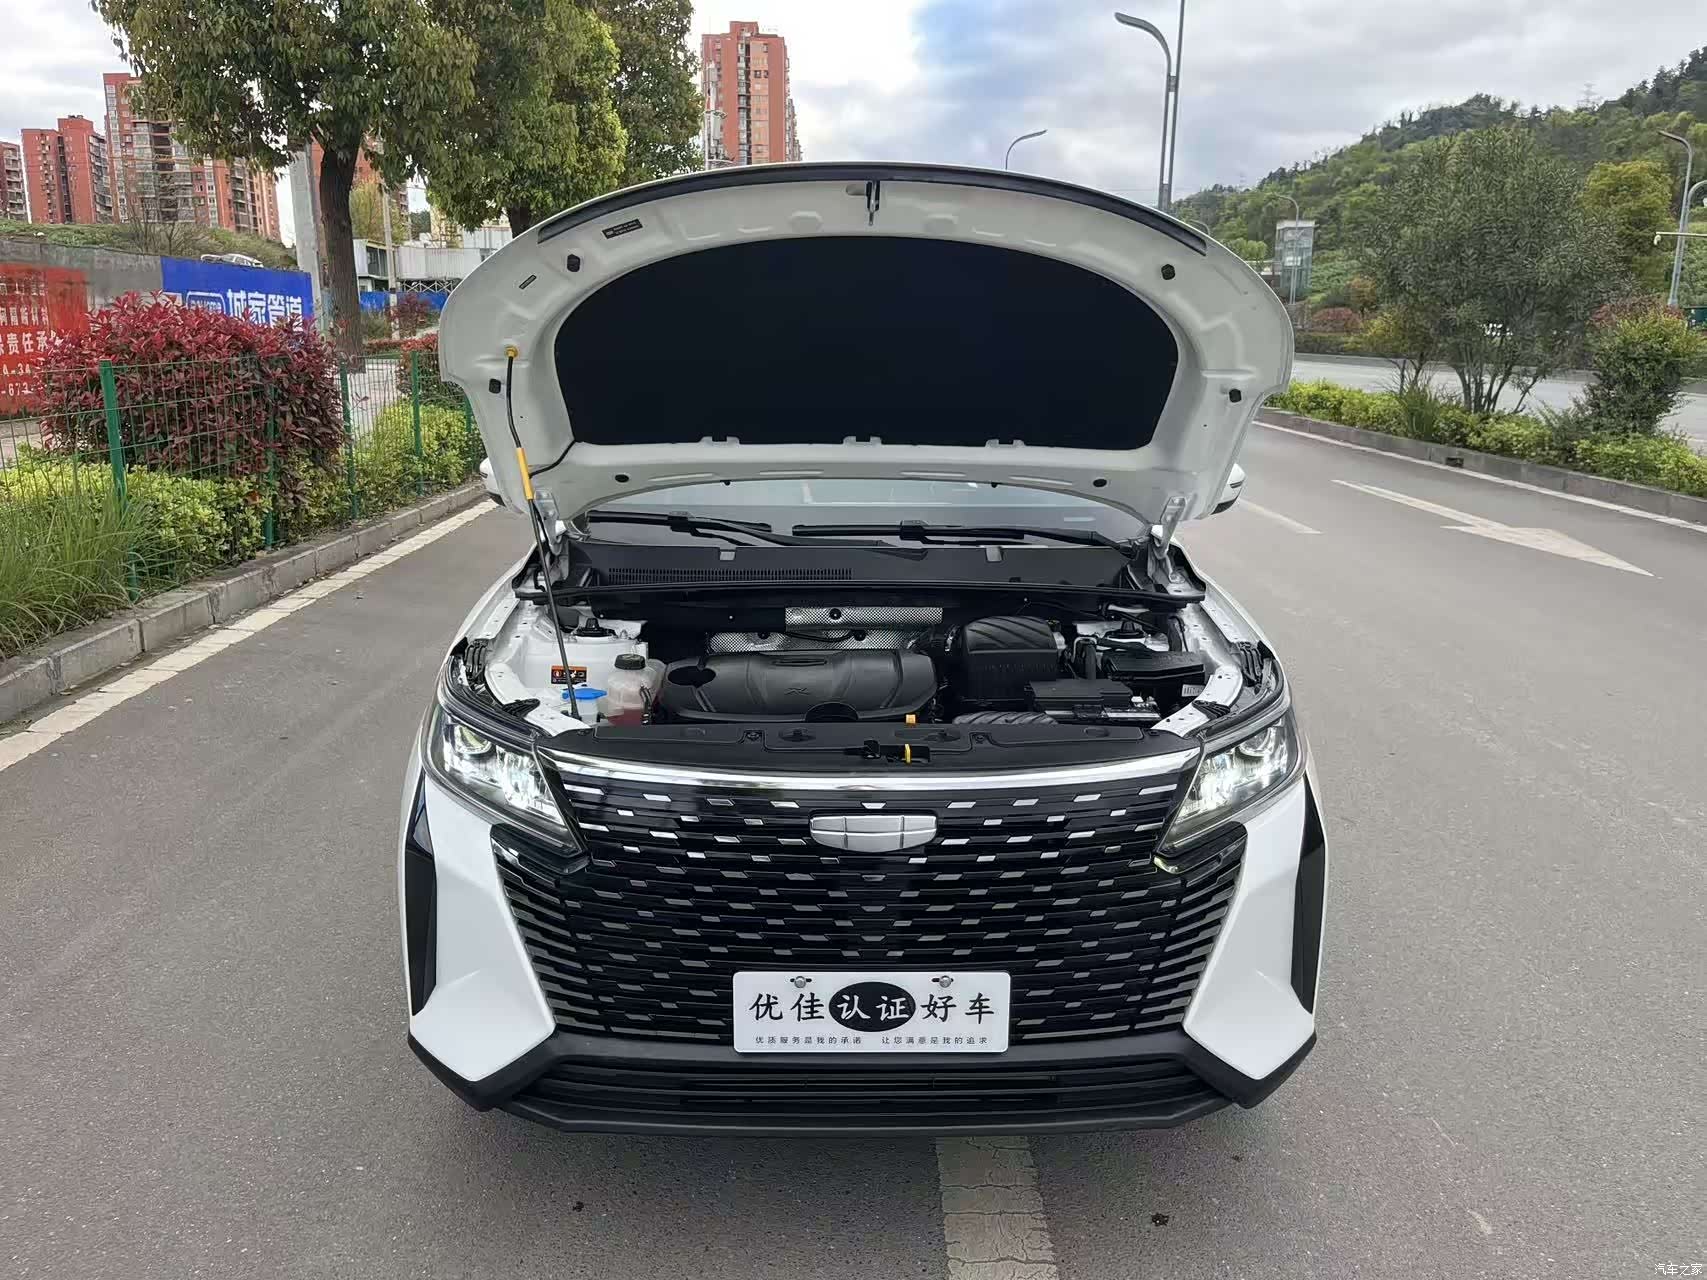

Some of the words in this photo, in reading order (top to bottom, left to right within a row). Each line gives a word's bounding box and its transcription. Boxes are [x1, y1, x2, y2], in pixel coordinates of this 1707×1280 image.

[750, 992, 995, 1025] 优佳认证好车
[755, 1036, 862, 1045] 优质服务是我的承诺
[881, 1036, 988, 1045] 让您满意是我的追求
